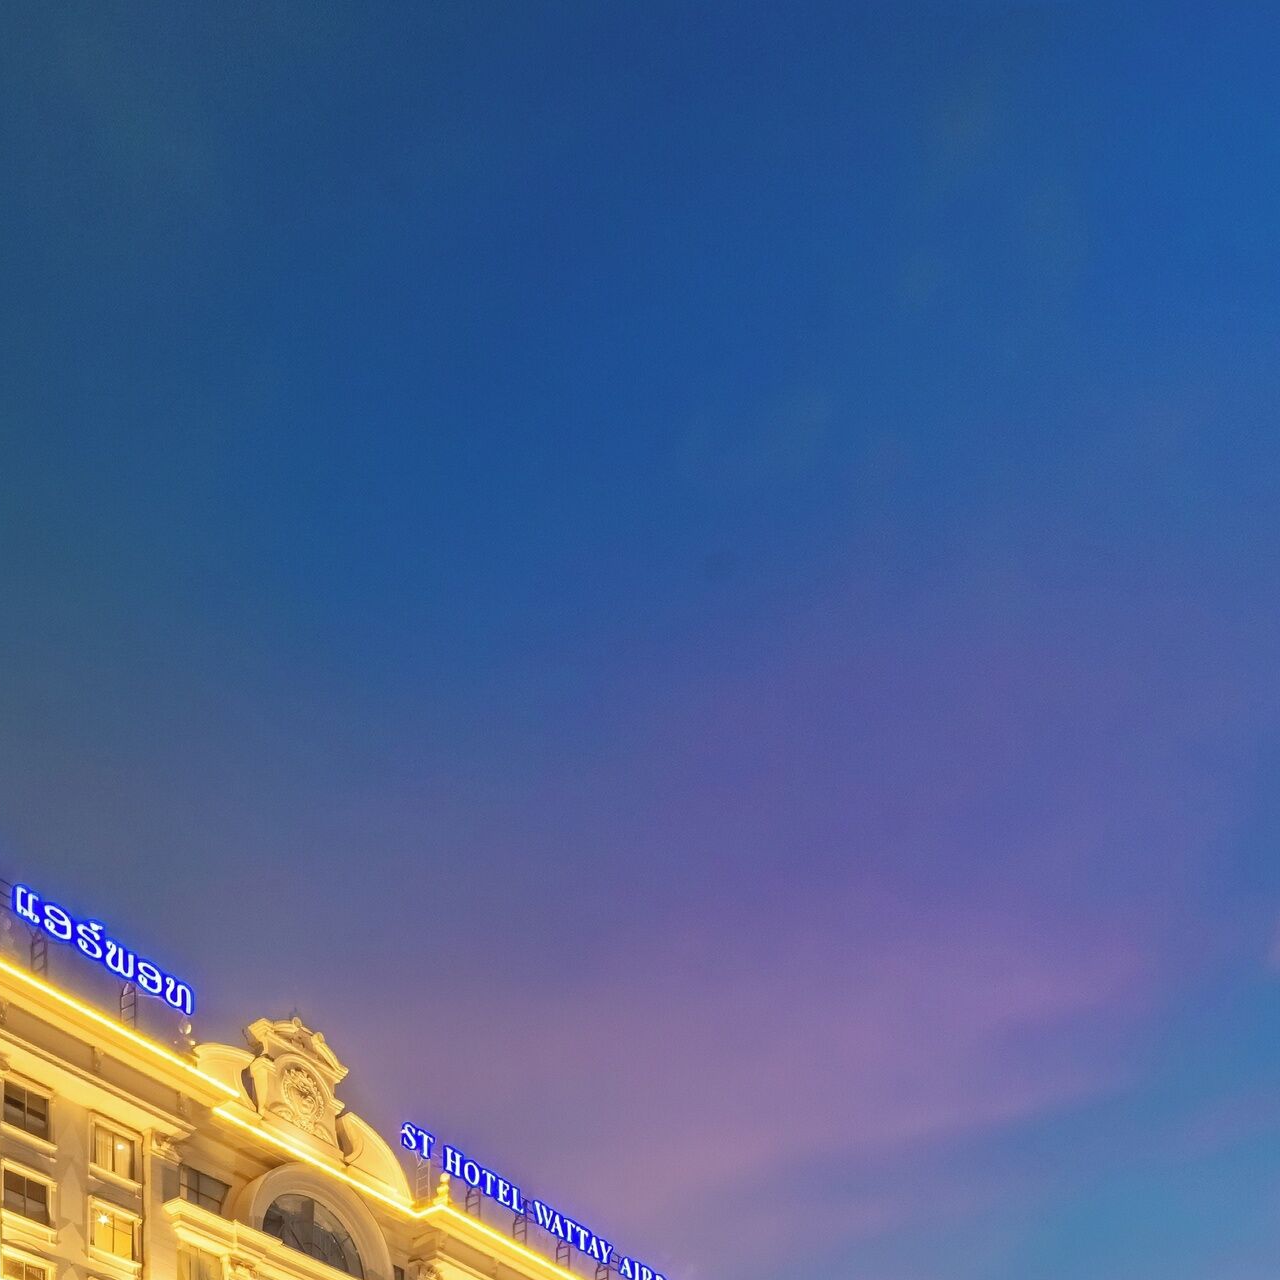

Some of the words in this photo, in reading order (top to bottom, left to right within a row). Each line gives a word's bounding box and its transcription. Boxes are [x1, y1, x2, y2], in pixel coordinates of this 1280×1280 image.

[402, 1123, 434, 1158] ST
[444, 1146, 524, 1214] HOTEL
[533, 1200, 613, 1264] WATTAY
